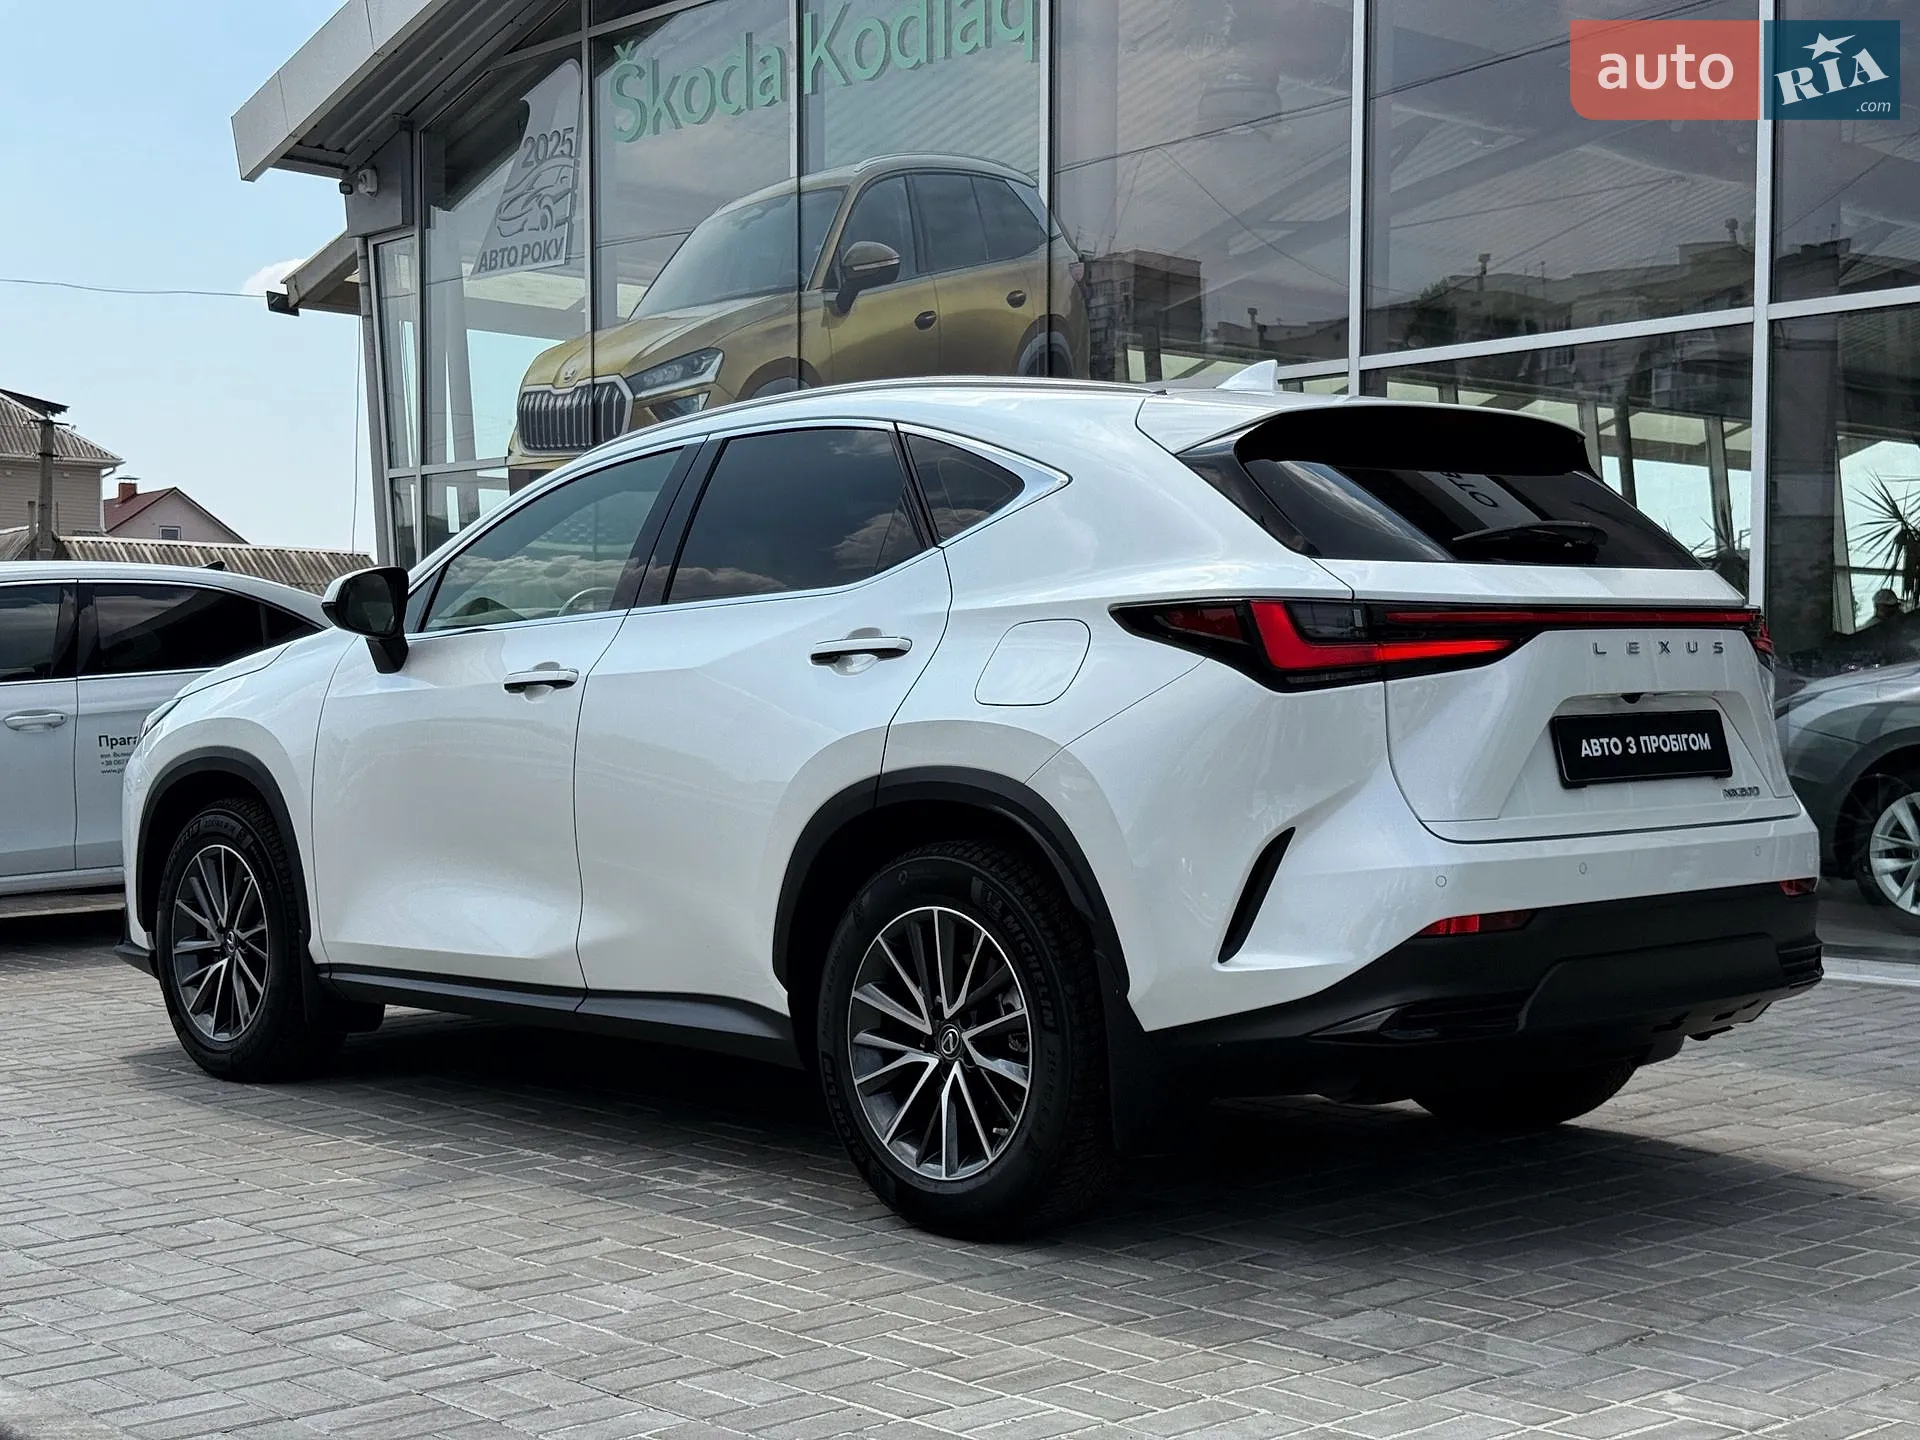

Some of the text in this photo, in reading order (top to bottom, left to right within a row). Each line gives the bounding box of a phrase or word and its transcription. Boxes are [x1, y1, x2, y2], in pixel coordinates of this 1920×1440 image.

[610, 31, 788, 143] Škoda
[521, 126, 575, 169] 2025
[478, 236, 565, 273] АВТО РОКУ
[1592, 640, 1724, 656] LEXUS
[1581, 732, 1712, 757] АВТО З ПРОБІГОМ
